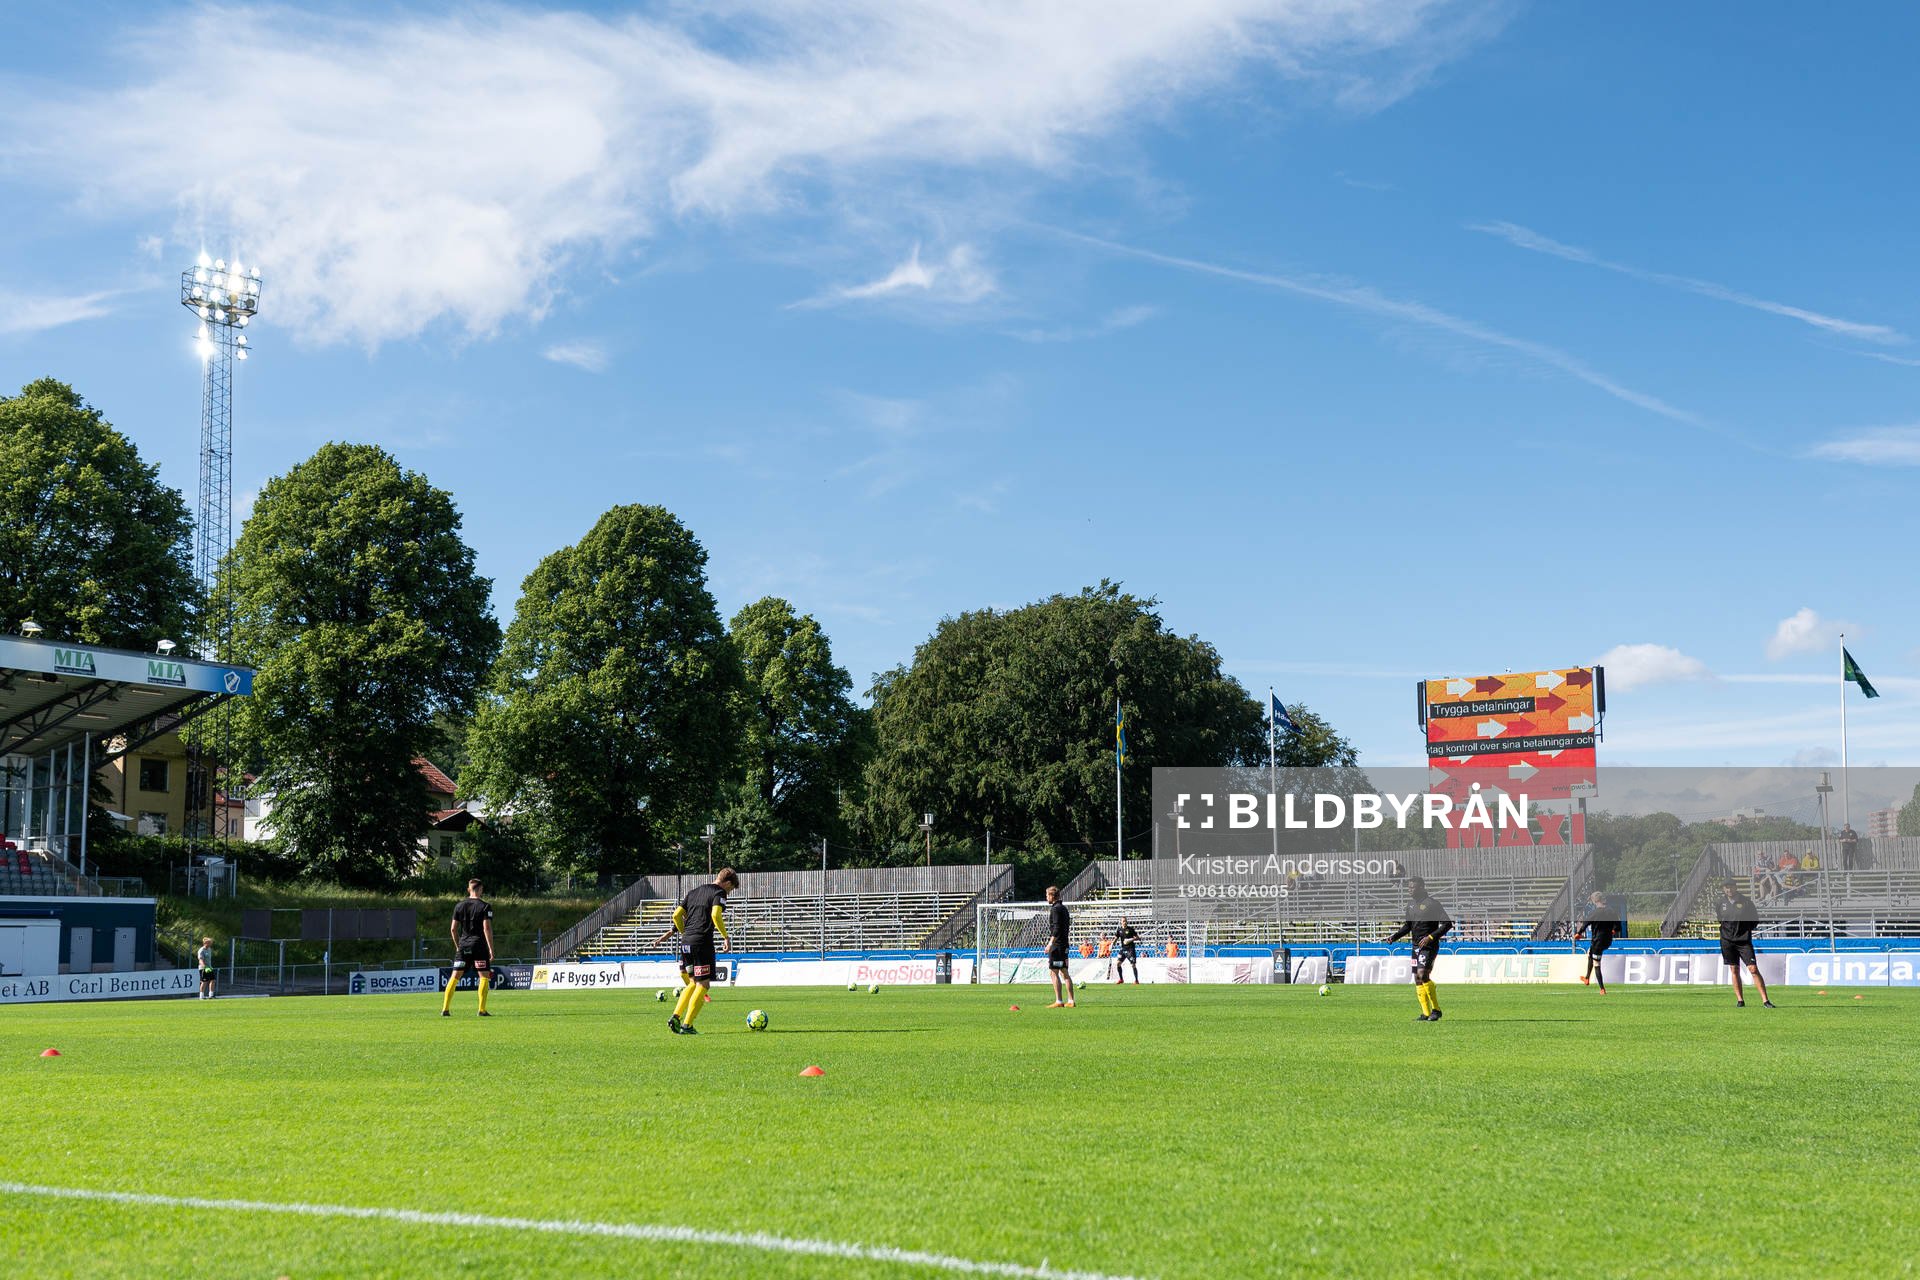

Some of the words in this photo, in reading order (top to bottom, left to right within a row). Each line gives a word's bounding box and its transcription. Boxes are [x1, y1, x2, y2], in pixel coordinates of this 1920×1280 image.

[55, 648, 95, 669] MTA
[148, 661, 186, 680] MTA
[1434, 704, 1469, 717] Trygga
[1472, 700, 1530, 713] betalningar
[1445, 743, 1478, 753] kontroll
[1502, 740, 1521, 750] sina
[1523, 737, 1575, 749] betalningar
[1576, 736, 1594, 745] och
[1464, 957, 1550, 978] HYLTE
[69, 977, 103, 994] Carl
[110, 977, 166, 993] Bennet
[171, 973, 193, 989] AB
[370, 976, 415, 988] BOFAST
[418, 975, 435, 986] AB
[441, 975, 472, 987] bns
[552, 972, 565, 983] AF
[568, 971, 596, 986] Bygg
[599, 970, 620, 984] Syd
[24, 980, 49, 996] AB
